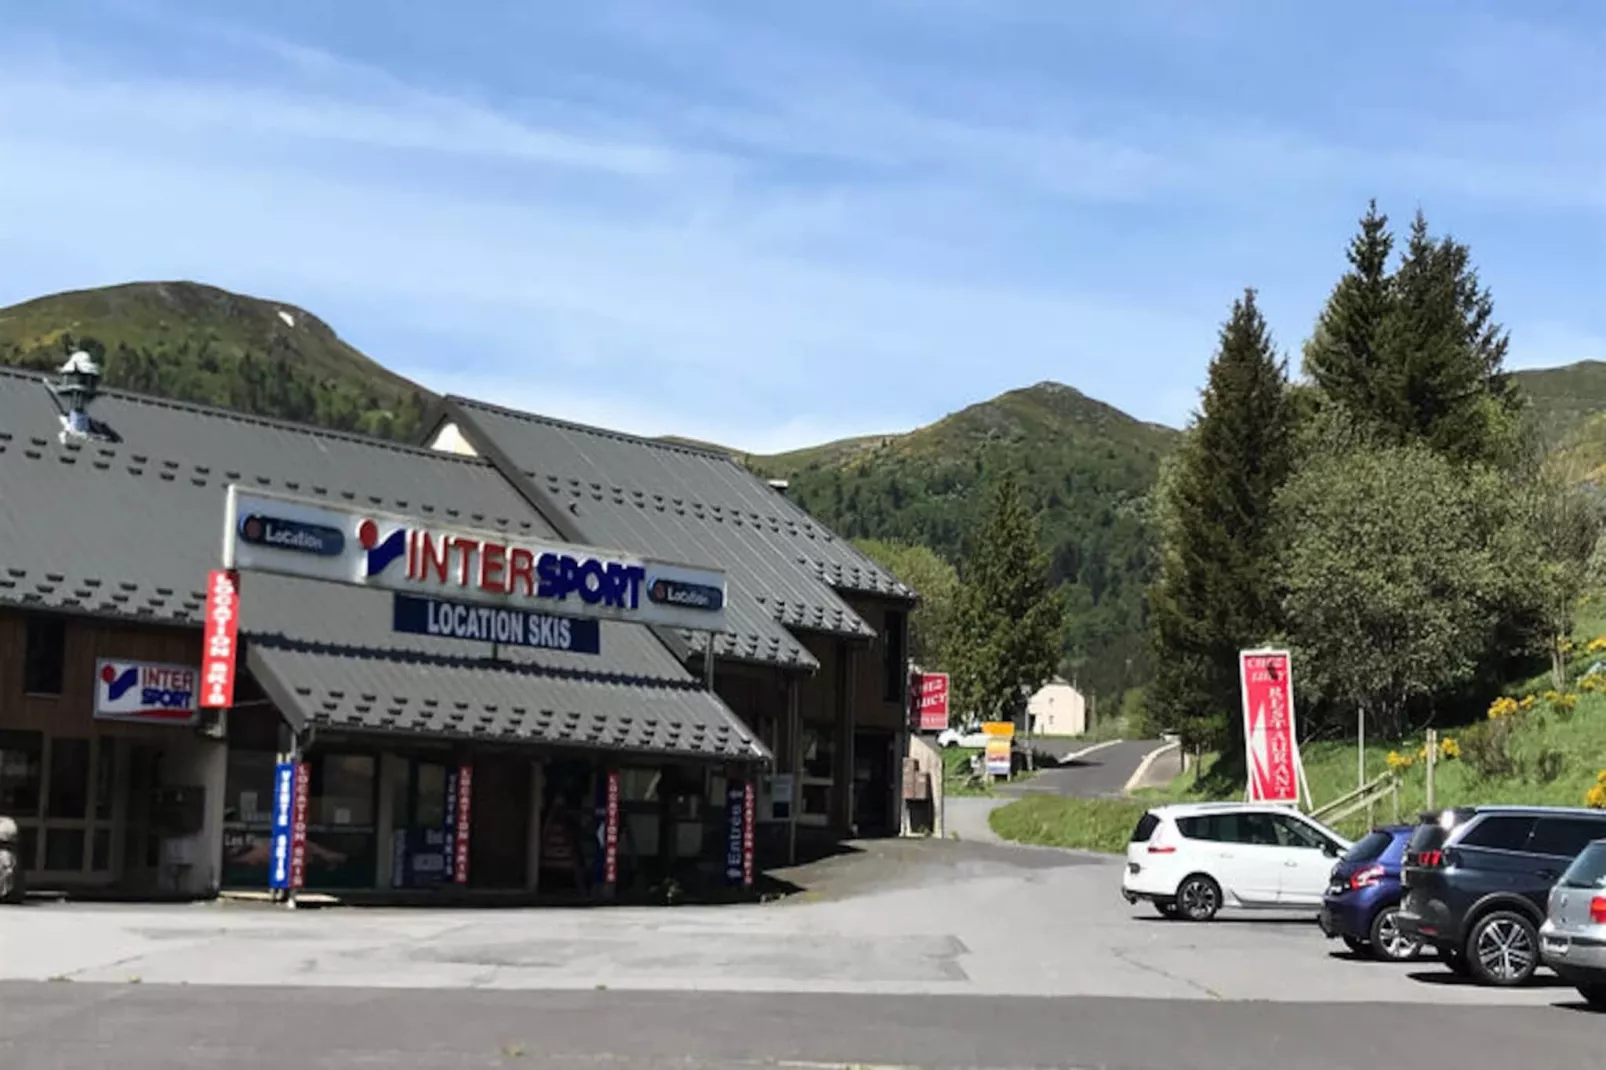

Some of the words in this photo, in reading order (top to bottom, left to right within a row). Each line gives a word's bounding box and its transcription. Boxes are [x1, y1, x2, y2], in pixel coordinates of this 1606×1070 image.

[265, 525, 323, 549] Location
[406, 528, 645, 609] INTERSPORT
[667, 586, 709, 605] Location
[427, 600, 524, 643] LOCATION
[529, 612, 572, 648] SKIS
[142, 667, 193, 689] INTER
[141, 689, 192, 708] SPORT
[1269, 686, 1290, 798] RESTAURANT
[295, 765, 308, 841] LOCATION
